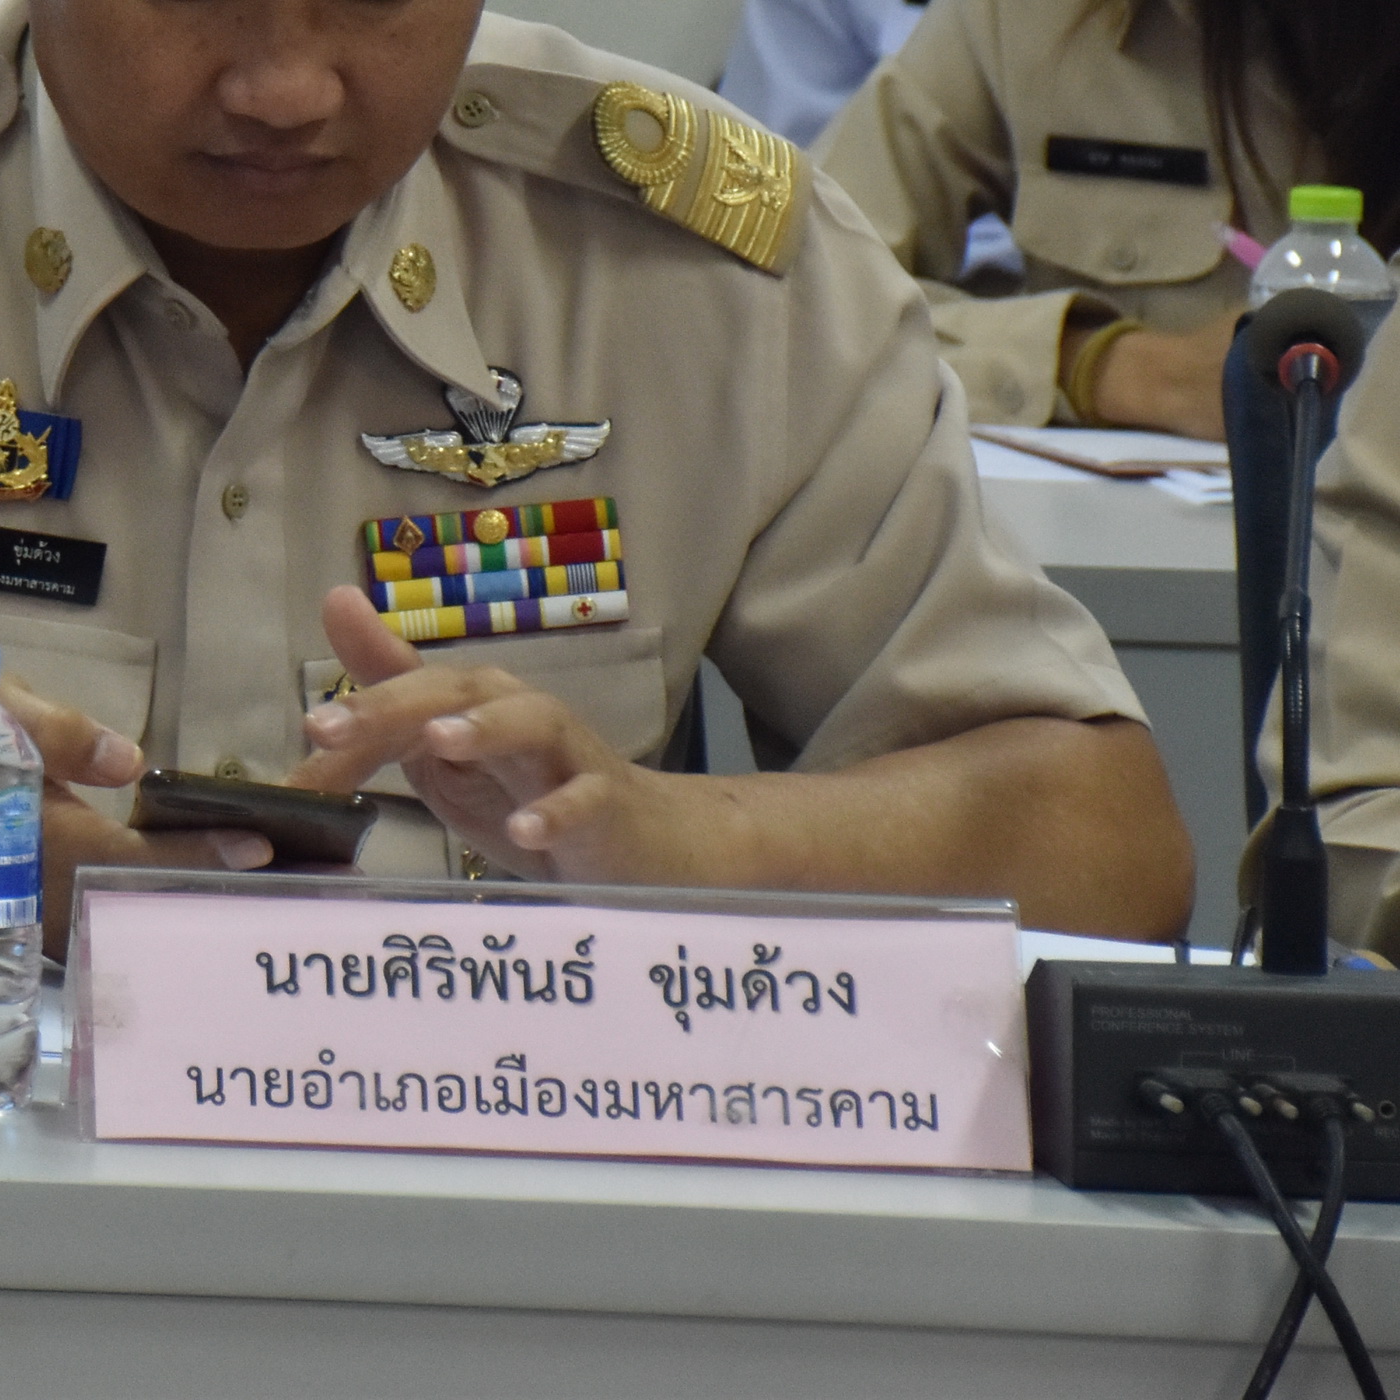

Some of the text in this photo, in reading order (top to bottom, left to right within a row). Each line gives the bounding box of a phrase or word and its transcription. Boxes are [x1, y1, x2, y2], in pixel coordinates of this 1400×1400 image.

[13, 537, 61, 567] ขุ่มด้วง
[255, 933, 857, 1033] นายศิริพันธ์ ขุ่มด้วง
[1090, 1005, 1192, 1021] PROFESSIONAL
[1090, 1018, 1245, 1037] CONFERENCE SYSTEM
[1222, 1048, 1254, 1062] LINE
[186, 1051, 939, 1131] นายอำเภอเมืองมหาสารคาม
